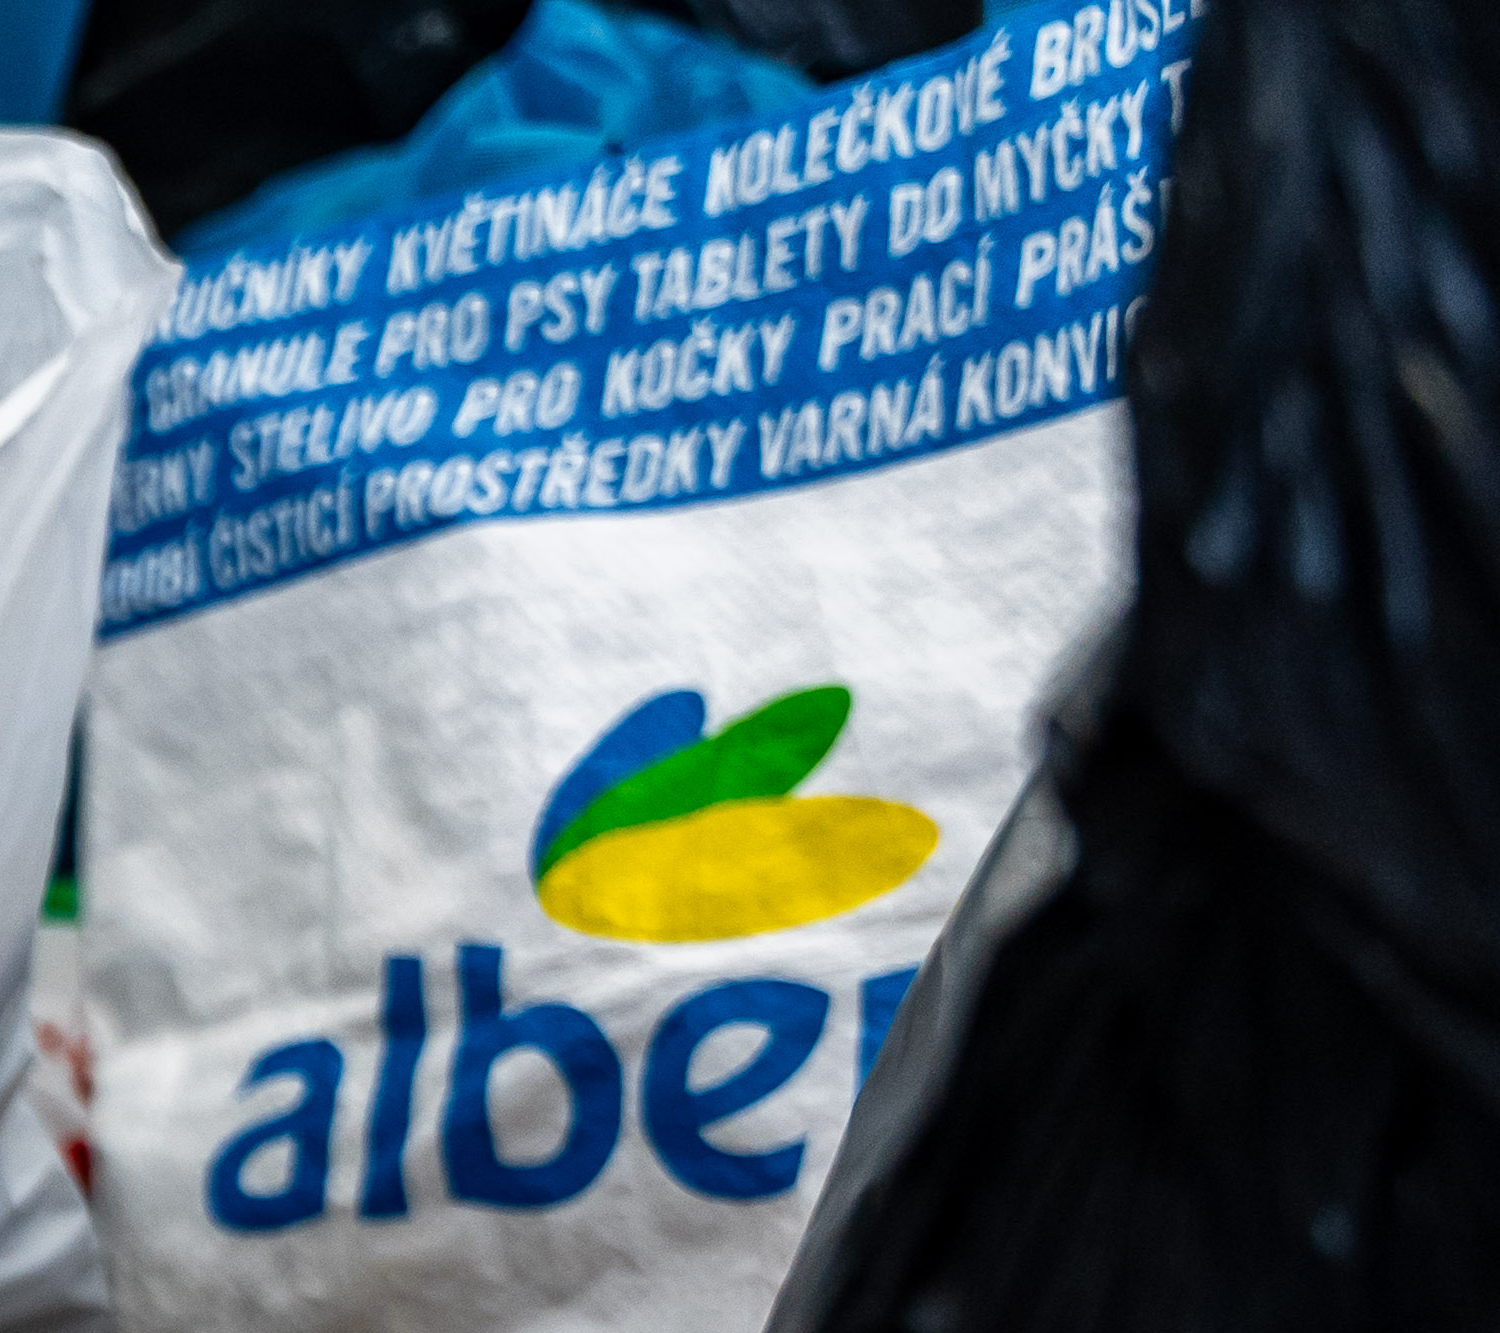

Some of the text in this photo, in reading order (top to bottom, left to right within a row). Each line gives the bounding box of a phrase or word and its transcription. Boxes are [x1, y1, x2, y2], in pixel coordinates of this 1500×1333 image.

[145, 316, 374, 434] GRANULE
[374, 291, 491, 378] PRO
[504, 263, 620, 353] PSY
[630, 194, 869, 325] TABLETY
[887, 166, 964, 259] DO
[973, 78, 1150, 224] MYČKY
[386, 153, 685, 296] KVĚTINÁČE
[704, 26, 1012, 217] KOLEČKOVÉ
[1030, 0, 1204, 100] BRUSL
[229, 386, 439, 493] STELIVO
[451, 359, 582, 438] PRO
[601, 312, 796, 419] KOČKY
[817, 230, 997, 373] PRACÍ
[1014, 165, 1172, 309] PRÁŠ
[364, 417, 747, 541] PROSTŘEDKY
[757, 352, 947, 480] VARNÁ
